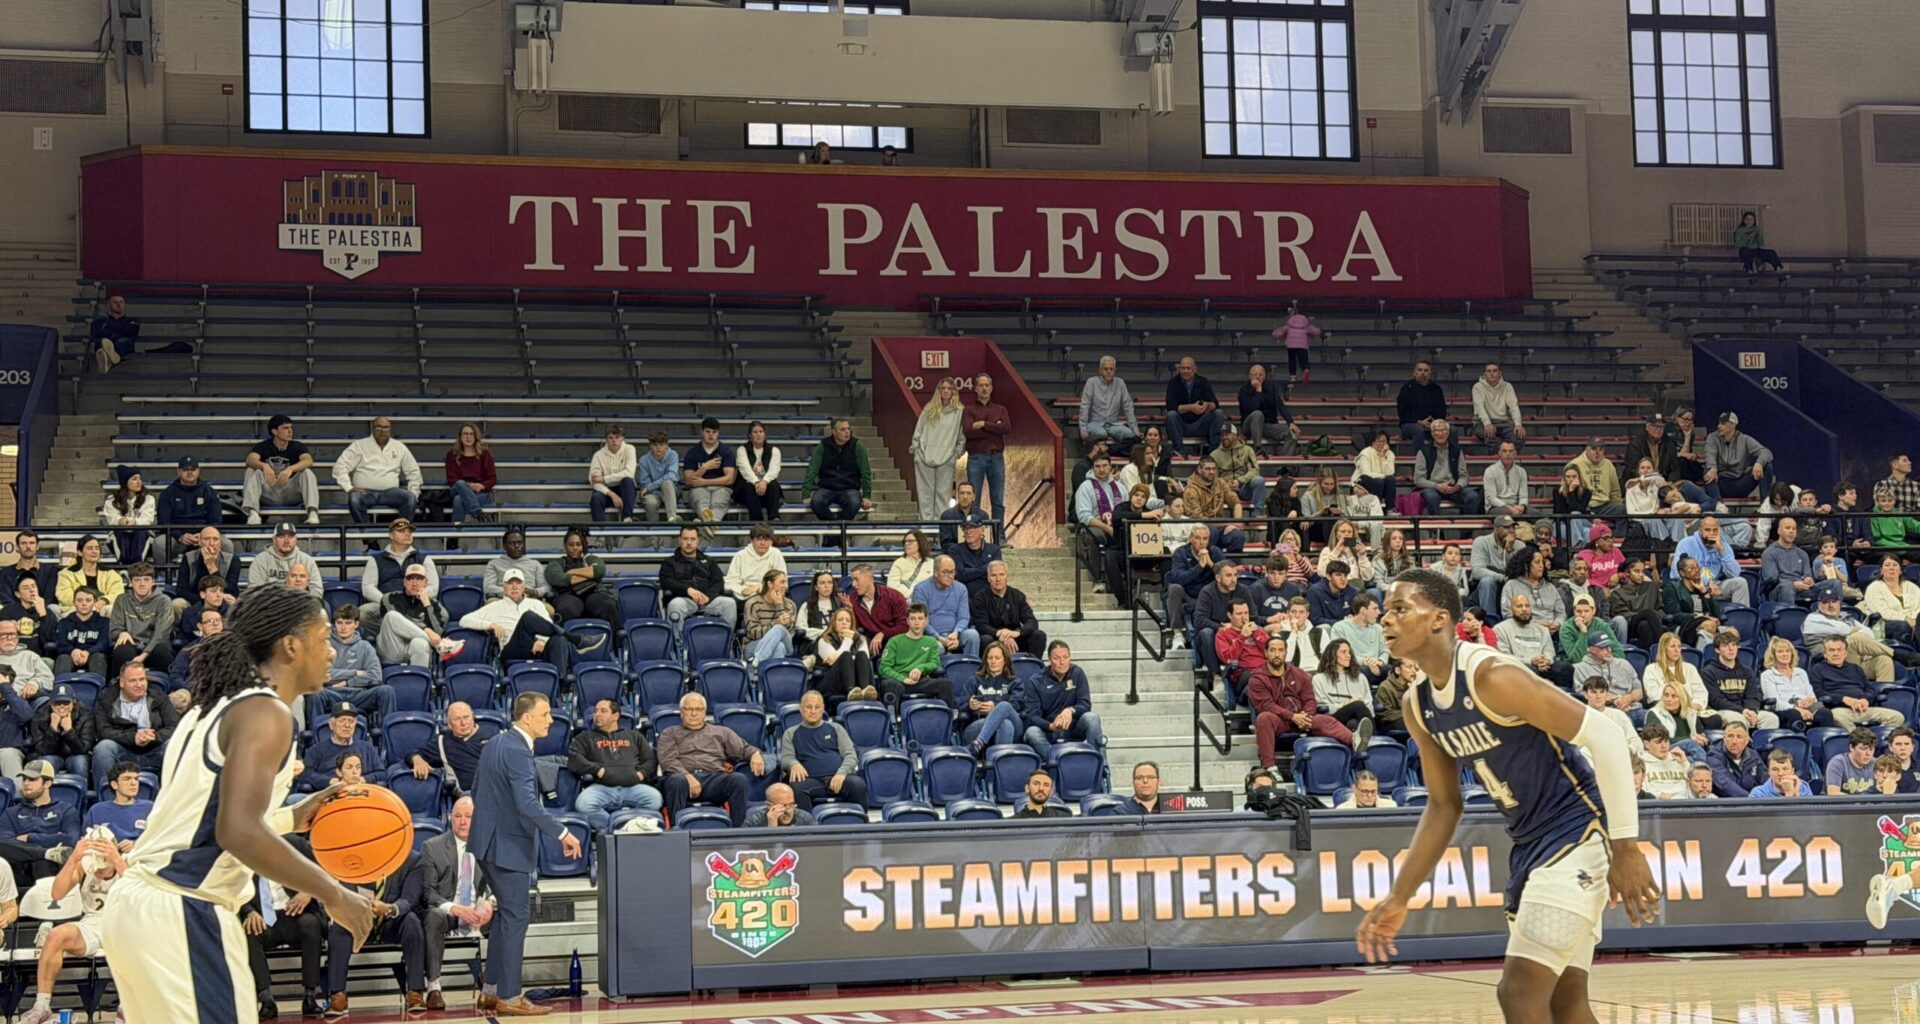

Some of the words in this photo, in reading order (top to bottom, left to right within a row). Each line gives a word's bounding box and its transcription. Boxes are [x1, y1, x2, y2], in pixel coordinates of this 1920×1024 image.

[288, 228, 320, 245] THE
[328, 229, 412, 247] PALESTRA
[508, 195, 756, 274] THE
[816, 202, 1404, 282] PALESTRA
[329, 257, 341, 265] EST
[344, 252, 359, 271] P
[925, 352, 945, 367] EXIT
[1743, 353, 1762, 368] EXIT
[904, 376, 924, 390] 03
[1762, 376, 1789, 390] 205
[1135, 532, 1159, 544] 104
[0, 541, 20, 554] 10
[1447, 721, 1502, 758] SALLE
[1473, 757, 1520, 809] 4
[1185, 796, 1209, 808] POSS.
[709, 885, 798, 900] STEAMFITTERS
[842, 852, 1297, 933] STEAMFITTERS
[1318, 845, 1504, 914] LOCAL
[1725, 836, 1844, 900] 420
[711, 899, 797, 930] 420
[921, 996, 1256, 1020] PENN
